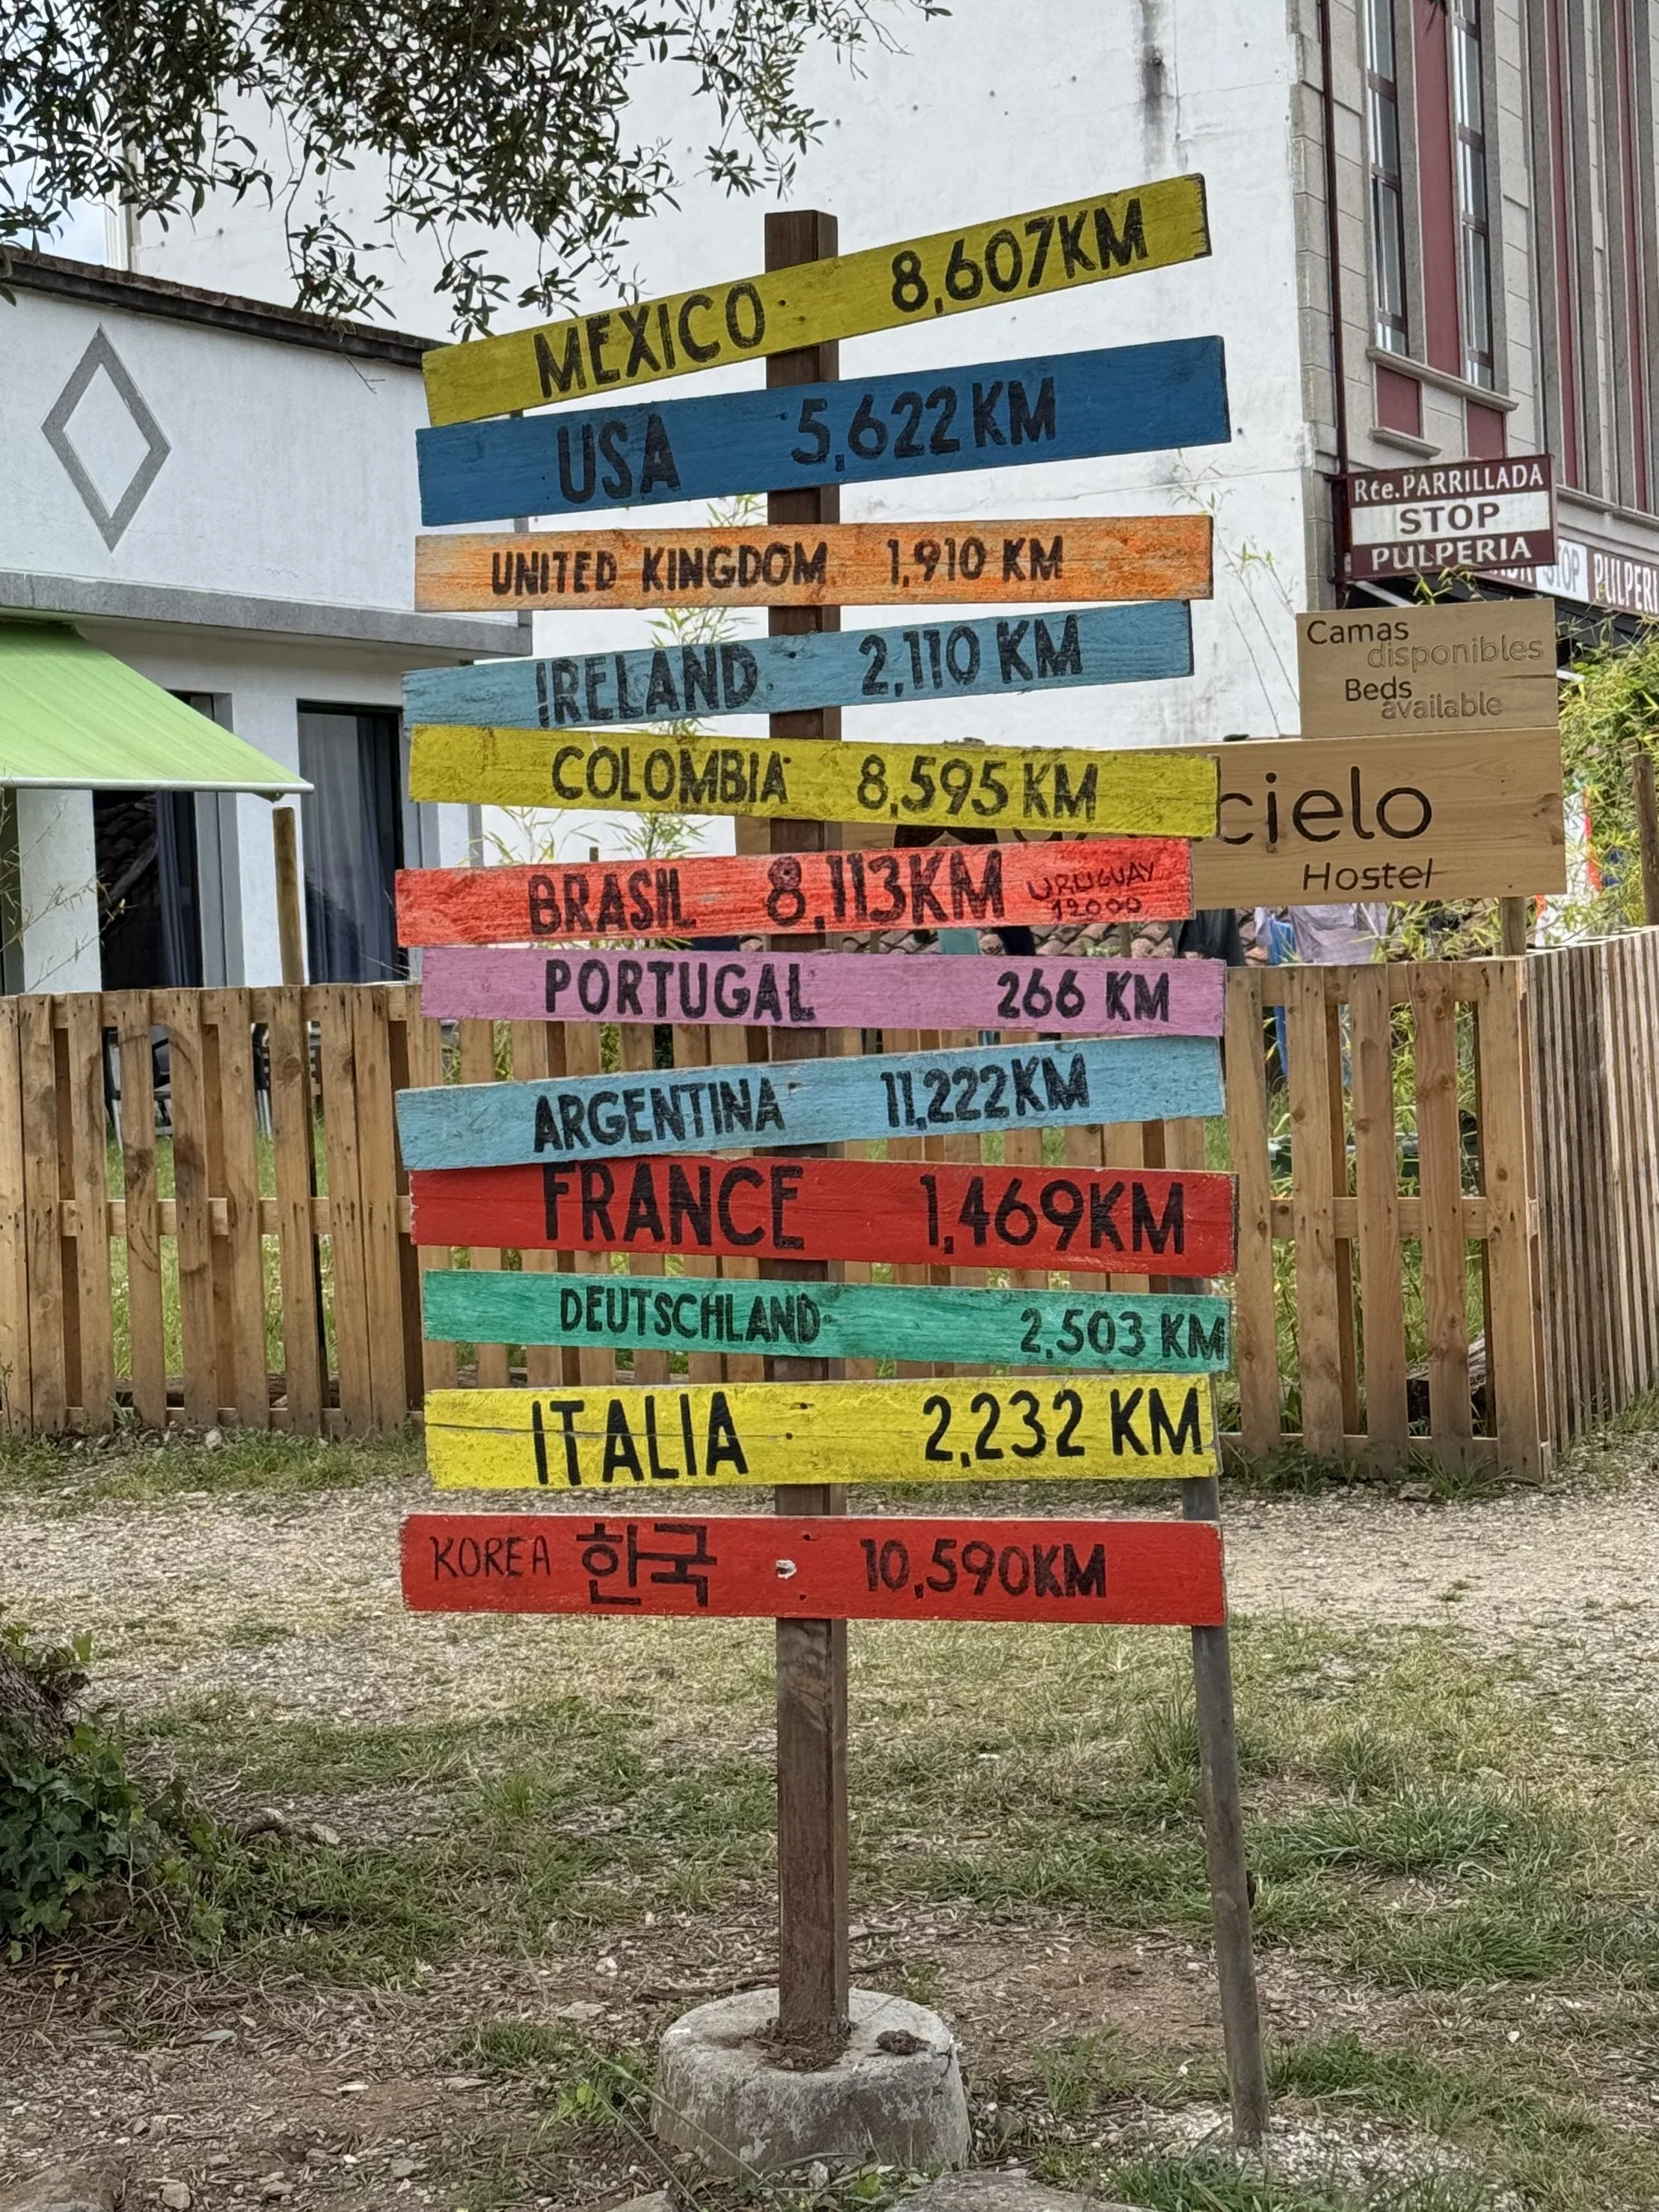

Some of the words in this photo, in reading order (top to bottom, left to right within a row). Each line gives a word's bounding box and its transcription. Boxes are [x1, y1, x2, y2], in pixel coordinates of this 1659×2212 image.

[533, 283, 764, 398] MEXICO
[556, 414, 681, 504] USA
[972, 376, 1056, 448] KM
[1402, 464, 1544, 498] PARRILLADA
[1399, 502, 1500, 535] STOP
[491, 549, 617, 596] UNITED
[642, 541, 828, 592] KINGDOM
[1002, 535, 1063, 582] KM
[1372, 537, 1533, 571] PULPERIA
[1307, 620, 1409, 645] Camas
[1367, 635, 1545, 672] disponibles
[536, 644, 758, 728] IRELAND
[997, 614, 1082, 683] KM
[1346, 675, 1412, 702] Beds
[1382, 692, 1503, 719] available
[551, 746, 789, 805] COLOMBIA
[1022, 763, 1099, 822] KM
[1219, 766, 1432, 845] cielo
[528, 868, 696, 935] BRASIL
[1028, 861, 1153, 900] URUGUAY
[1303, 858, 1432, 891] Hostel
[545, 959, 816, 1021] PORTUGAL
[997, 969, 1085, 1019] 266
[1106, 971, 1169, 1022] KM
[534, 1078, 785, 1152] ARGENTINA
[542, 1162, 805, 1250] FRANCE
[560, 1285, 821, 1345] DEUTSCHLAND
[1161, 1313, 1225, 1361] KM
[532, 1391, 749, 1486] ITALIA
[1110, 1387, 1203, 1456] KM
[429, 1535, 551, 1579] KOREA
[576, 1522, 717, 1607] 한국
